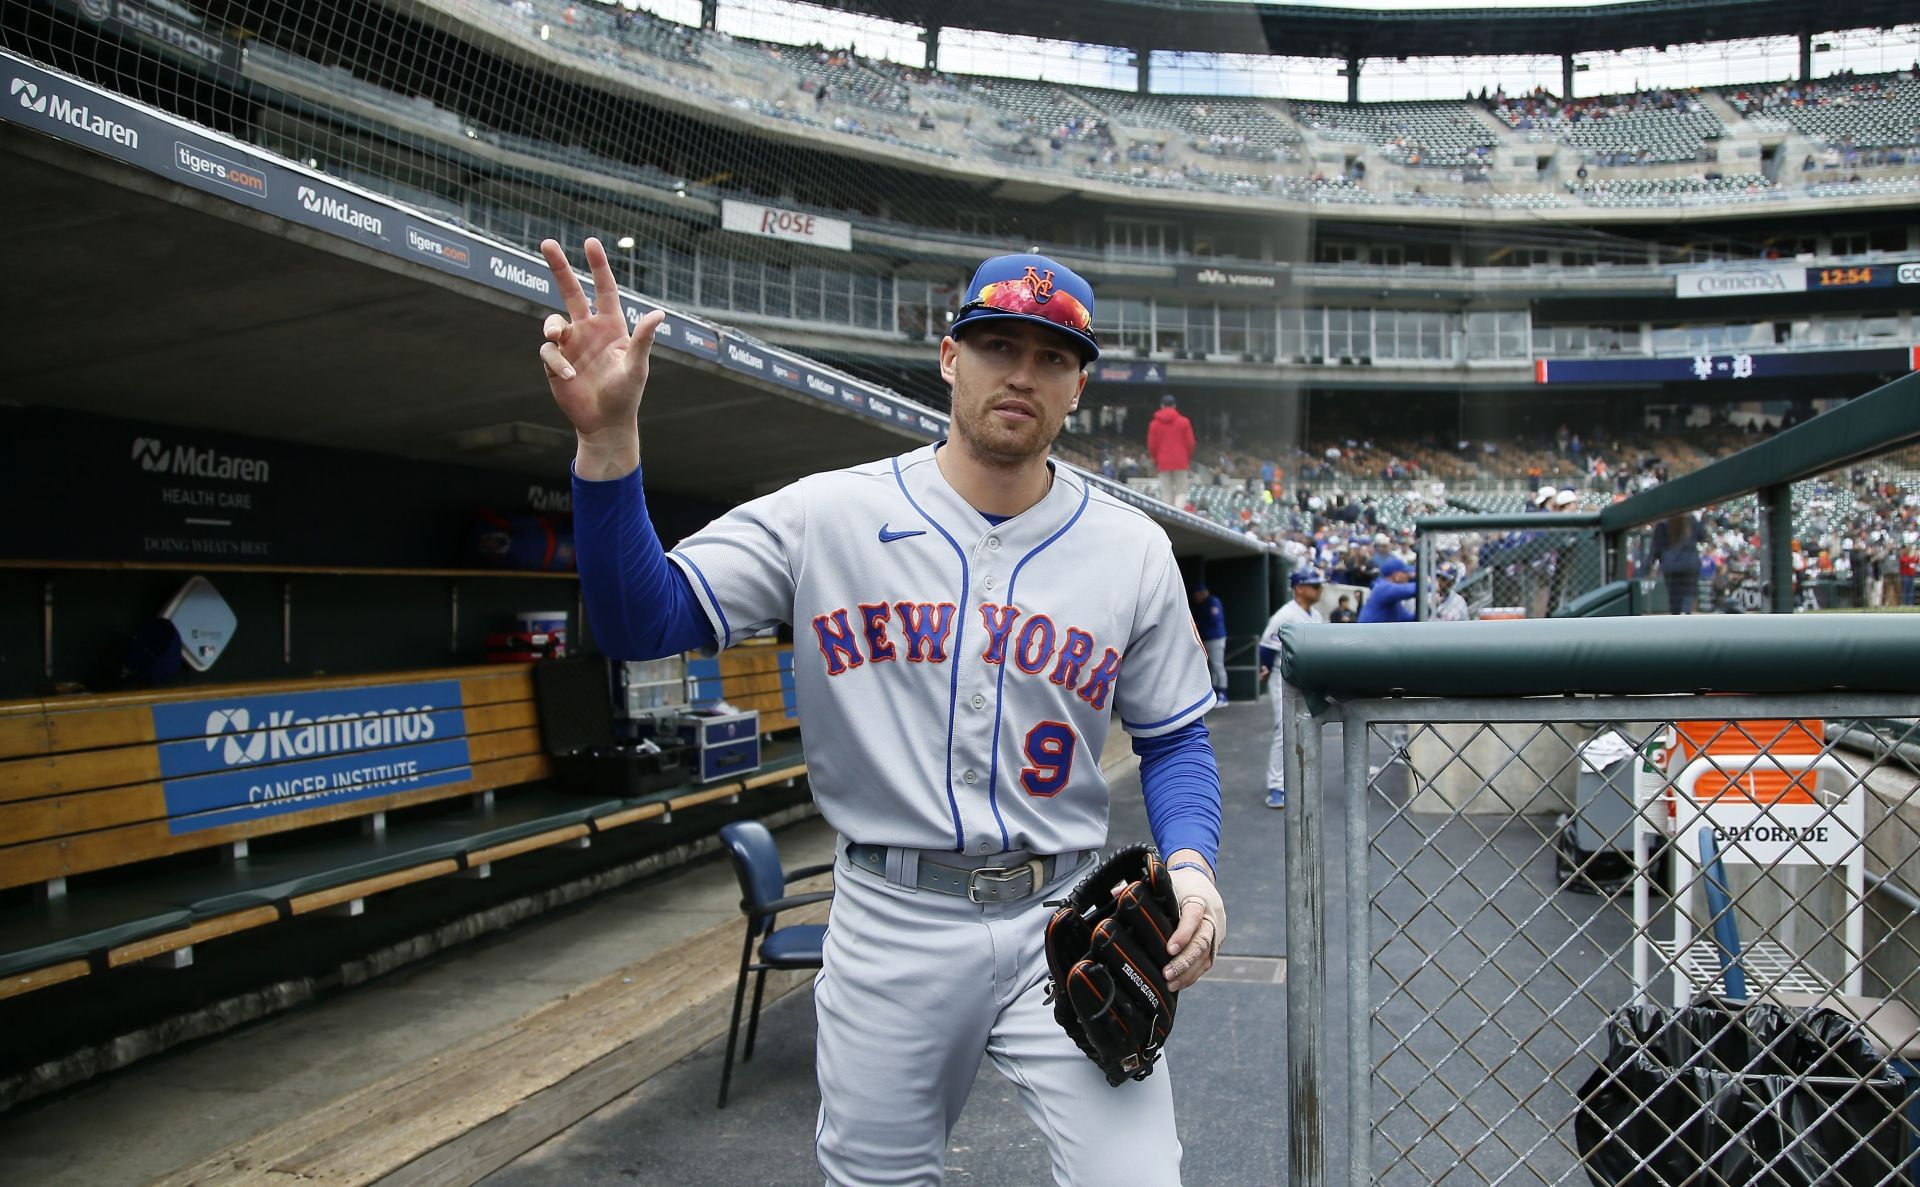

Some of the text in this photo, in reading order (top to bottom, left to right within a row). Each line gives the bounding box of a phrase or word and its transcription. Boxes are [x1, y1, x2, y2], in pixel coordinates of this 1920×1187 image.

[48, 94, 139, 150] McLaren
[179, 147, 263, 192] tigers.com
[321, 195, 382, 236] McLaren
[761, 208, 817, 235] ROSE
[408, 230, 468, 263] tigers.com
[506, 264, 549, 294] McLaren
[1819, 267, 1873, 286] 12:54
[172, 445, 270, 483] McLaren
[162, 487, 252, 509] HEALTH CARE
[144, 537, 190, 552] DOING
[812, 601, 1123, 710] NEW YORK
[268, 705, 436, 760] Karmanos
[1019, 720, 1077, 798] 9
[248, 761, 419, 810] CANCER INSTITUTE
[1713, 826, 1829, 842] GATORADE
